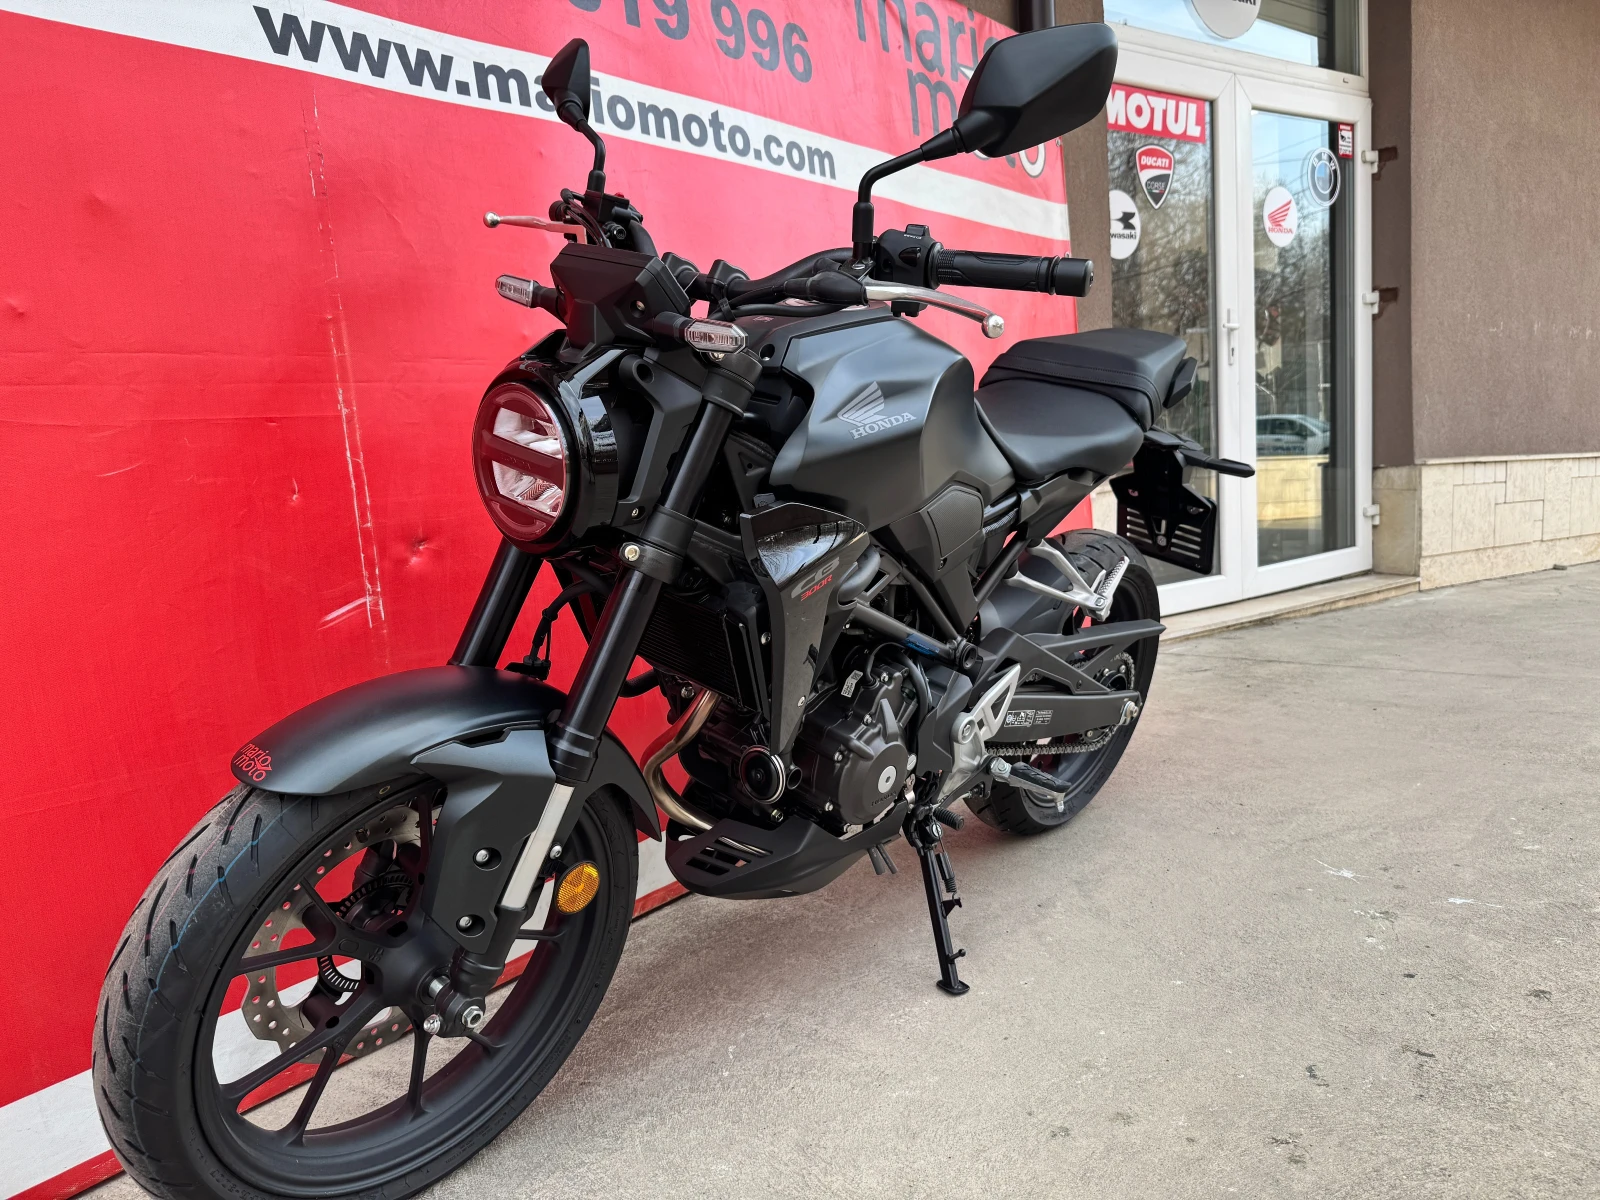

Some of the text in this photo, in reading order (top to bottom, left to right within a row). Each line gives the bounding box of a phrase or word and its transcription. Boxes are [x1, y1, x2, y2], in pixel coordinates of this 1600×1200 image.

[711, 0, 813, 83] 996
[852, 0, 998, 82] mari
[252, 5, 836, 180] www.miomoto.com
[1106, 90, 1201, 137] MOTUL
[1140, 155, 1169, 168] DUCATI
[1146, 181, 1166, 190] CORSE
[1110, 231, 1137, 239] wasaki
[849, 412, 917, 440] HONDA
[790, 556, 840, 599] CB
[800, 574, 833, 601] 300R
[233, 754, 267, 782] moto
[241, 743, 272, 767] mario
